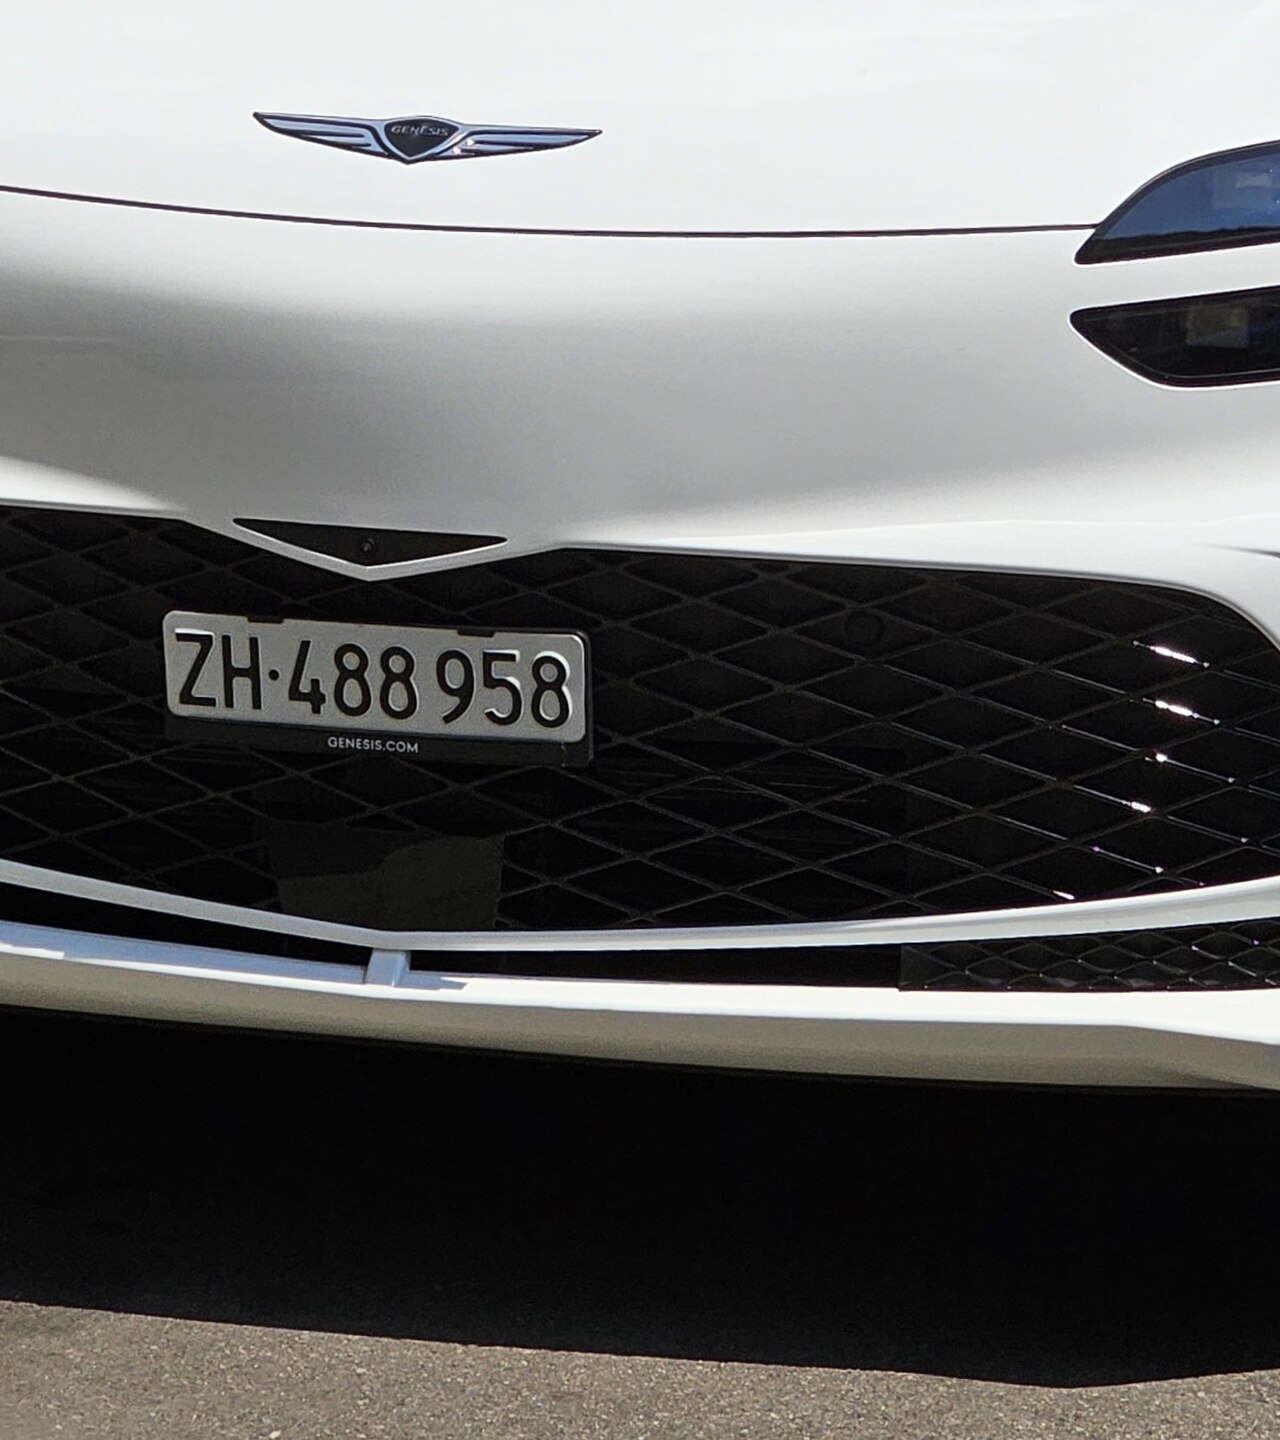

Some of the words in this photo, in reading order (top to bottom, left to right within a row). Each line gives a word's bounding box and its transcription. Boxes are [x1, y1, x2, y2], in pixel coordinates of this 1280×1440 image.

[391, 124, 450, 137] GENESIS
[436, 649, 573, 729] 958
[327, 735, 420, 754] GENESIS.COM
